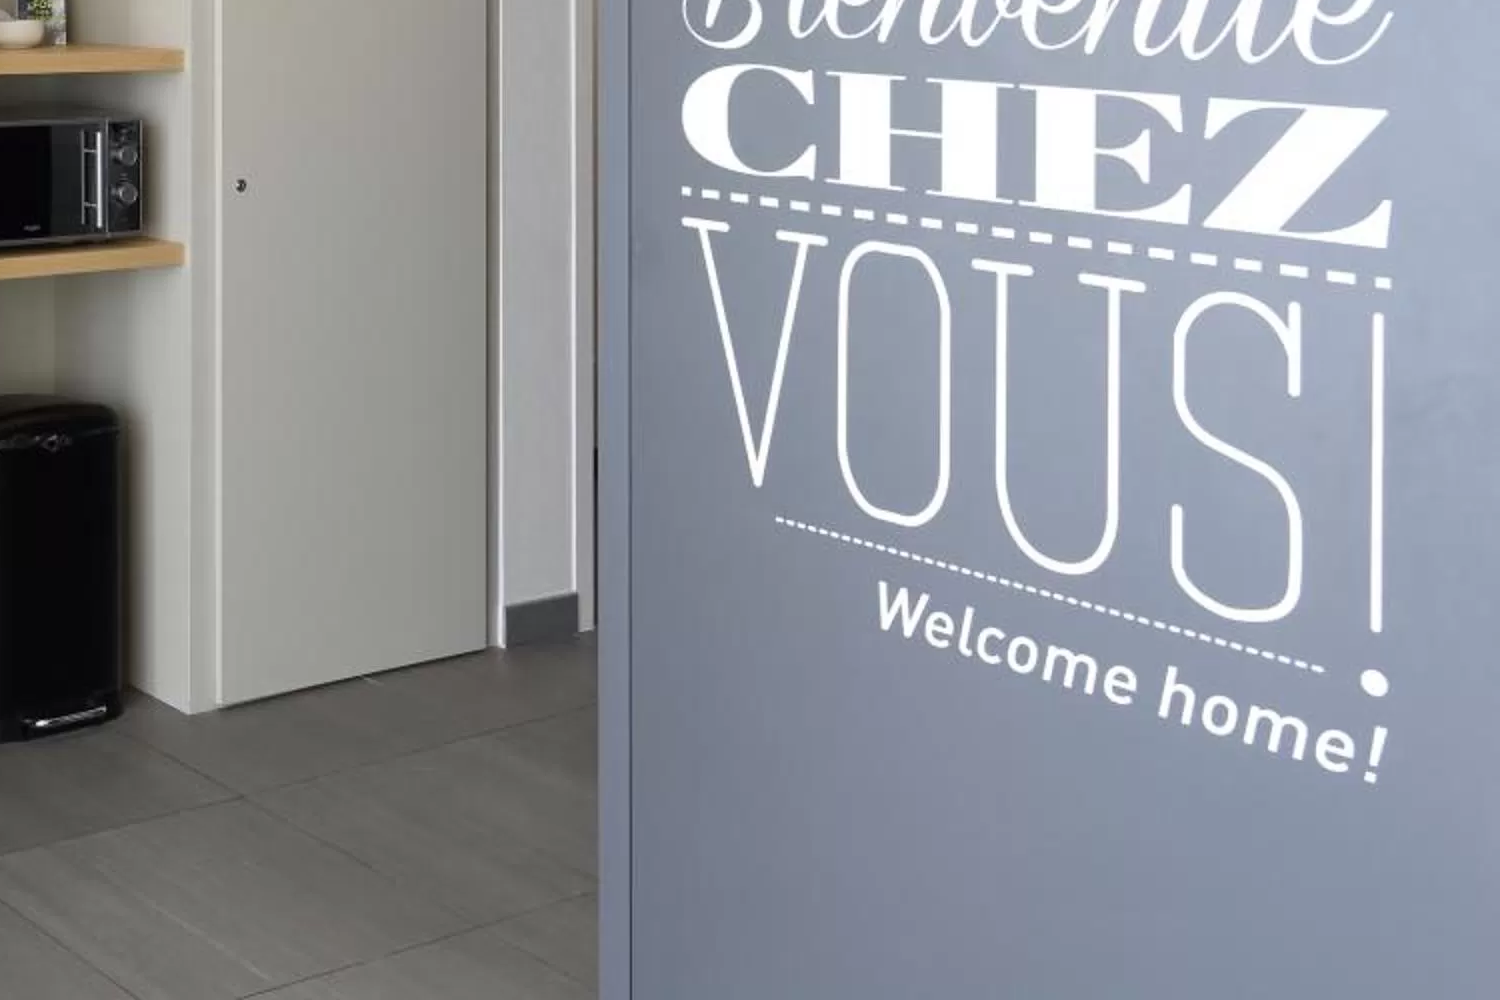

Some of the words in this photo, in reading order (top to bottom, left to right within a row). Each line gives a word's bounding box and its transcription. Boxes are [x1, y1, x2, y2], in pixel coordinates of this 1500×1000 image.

[682, 64, 1393, 249] CHEZ
[877, 580, 1138, 706] Welcome
[1158, 666, 1388, 783] home!
